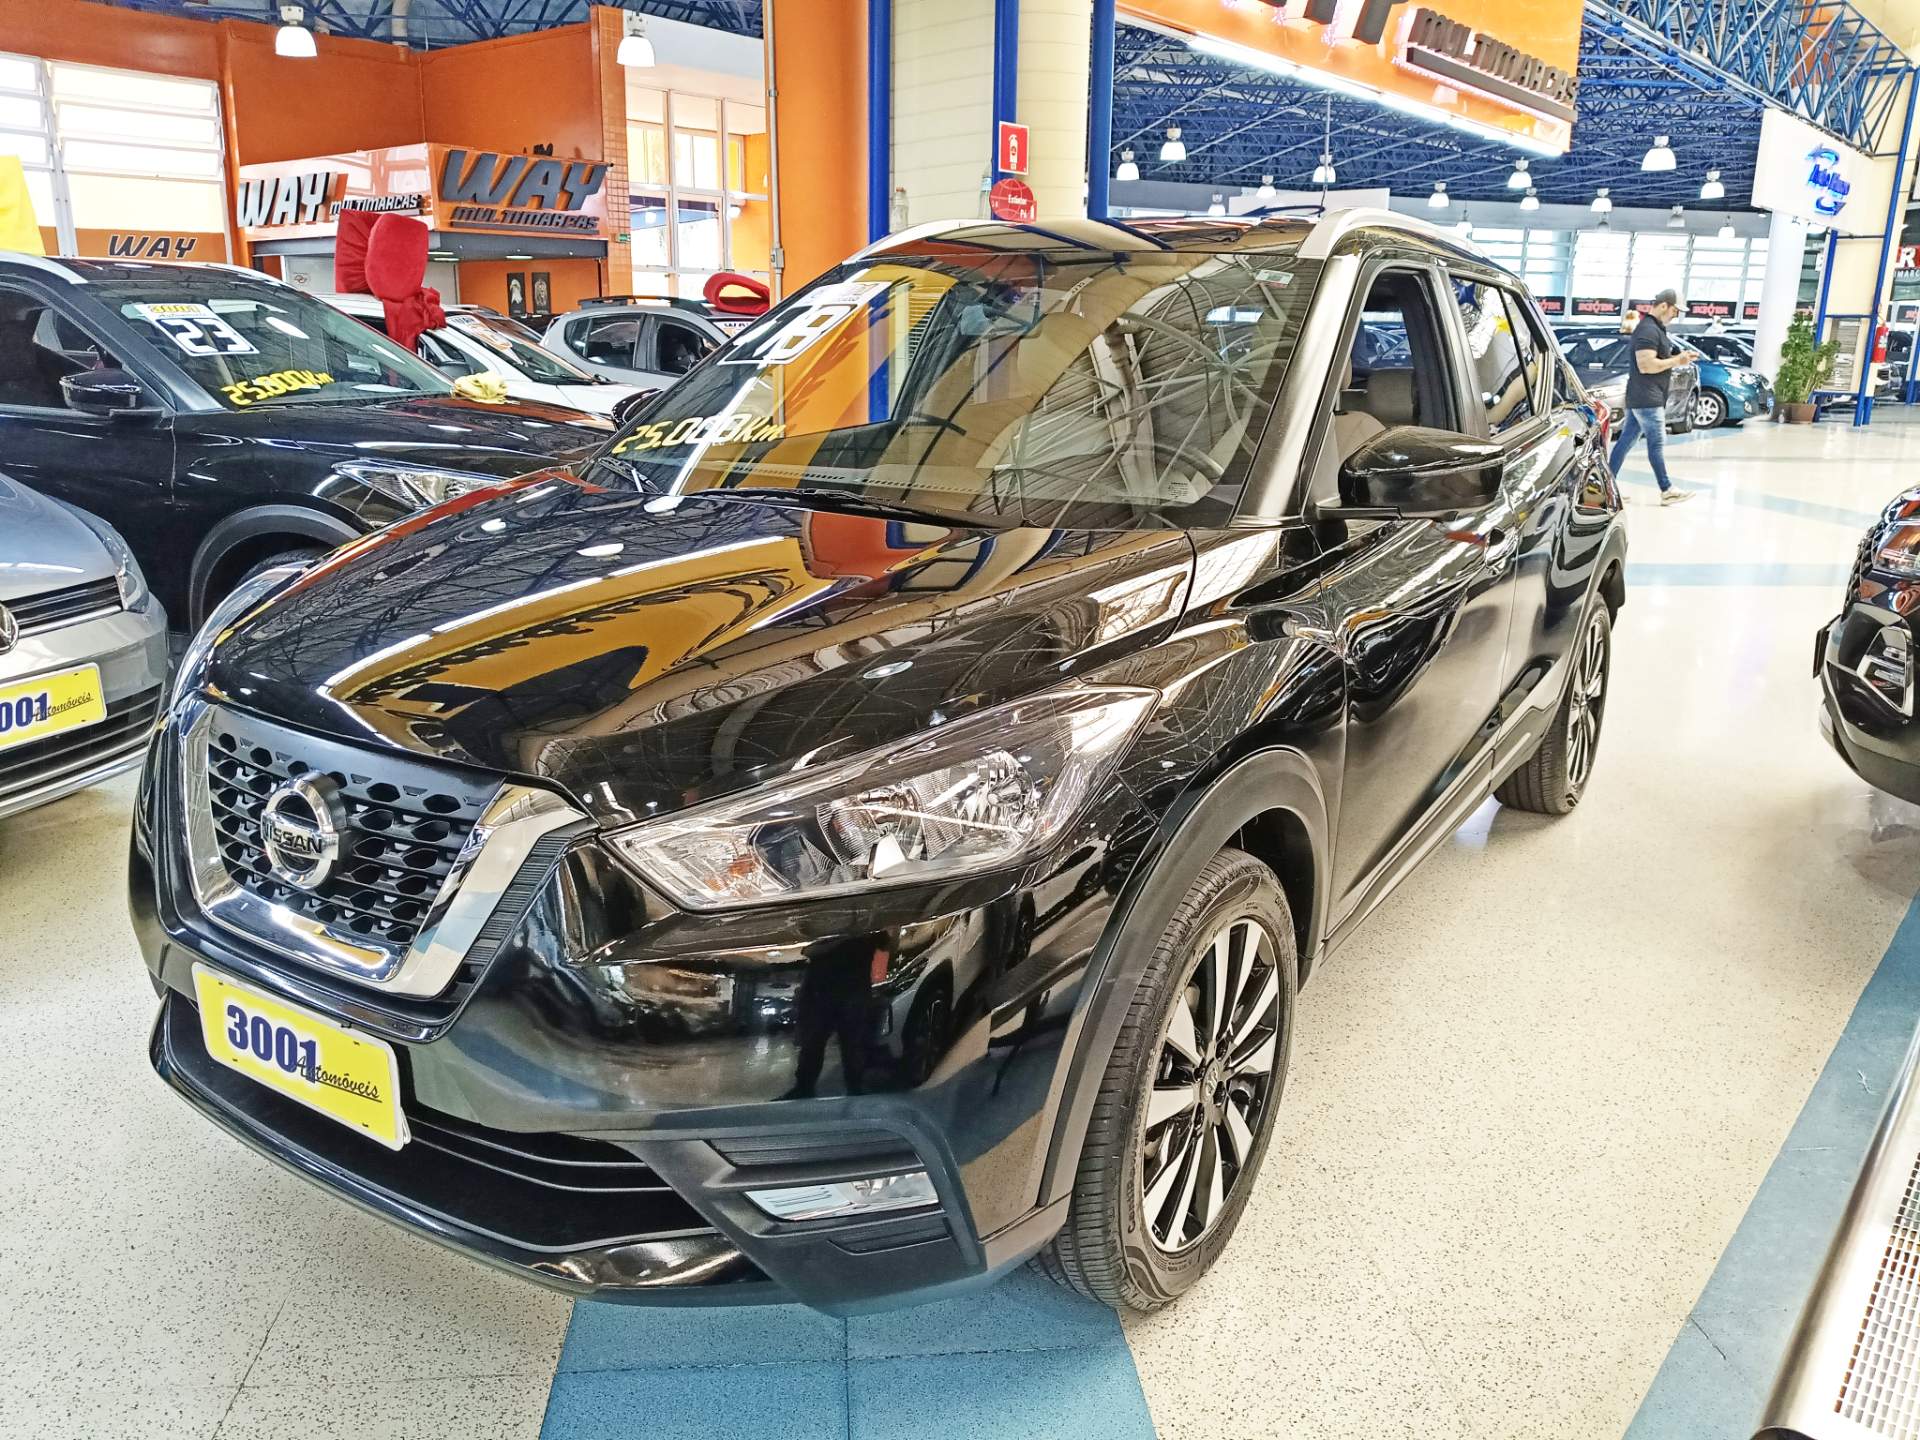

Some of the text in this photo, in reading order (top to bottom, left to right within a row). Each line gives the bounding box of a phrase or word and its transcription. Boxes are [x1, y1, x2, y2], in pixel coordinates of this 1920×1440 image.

[1408, 8, 1580, 106] MULTIMARCAS
[237, 172, 330, 227] WAY
[441, 149, 609, 211] WAY
[451, 207, 600, 229] MULTIMARCAS
[108, 235, 197, 258] WAY
[160, 318, 253, 353] 23
[262, 816, 322, 854] NISSAN
[227, 1004, 382, 1102] 3001 Automóveis
